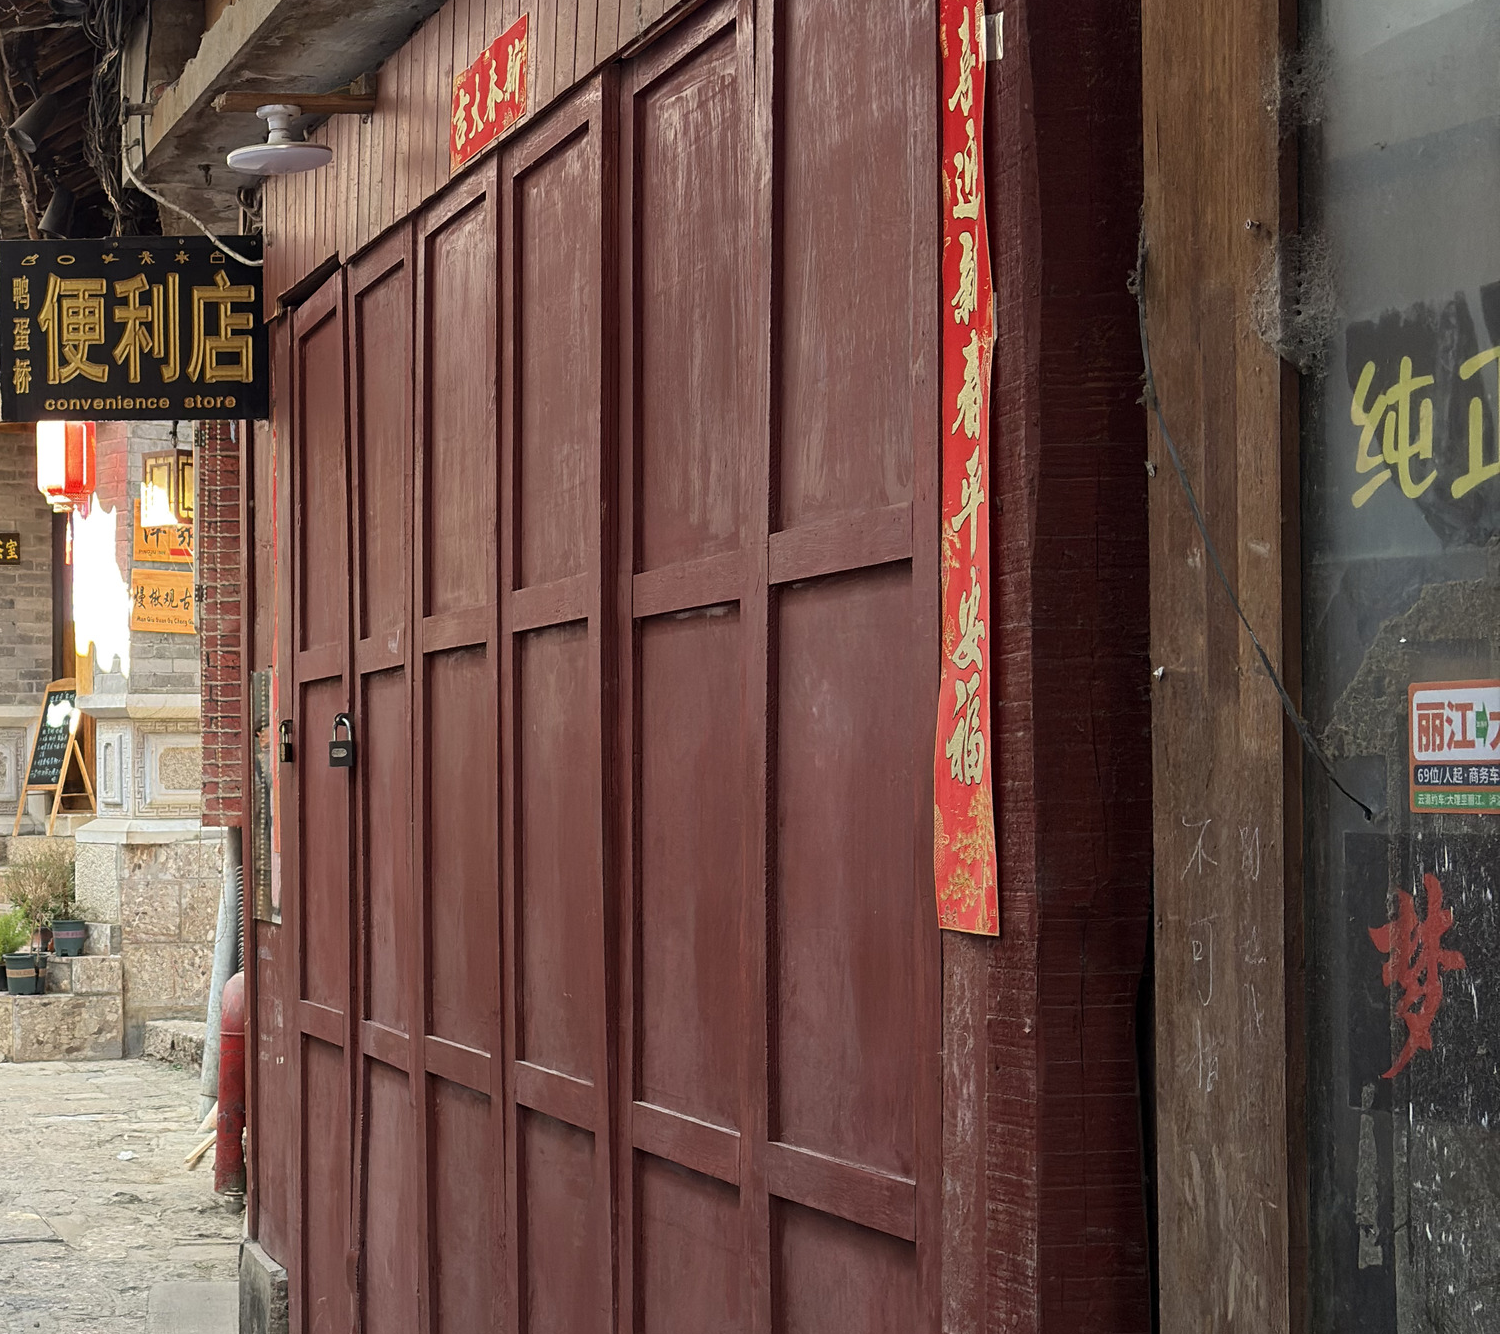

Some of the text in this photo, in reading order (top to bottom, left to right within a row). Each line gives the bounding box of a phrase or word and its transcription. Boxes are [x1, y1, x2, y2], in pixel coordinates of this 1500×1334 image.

[11, 274, 33, 395] 鸭蛋桥
[37, 269, 256, 385] 便利店
[43, 394, 237, 411] convenience store
[1416, 700, 1476, 752] 丽江
[1368, 873, 1466, 1079] 梦
